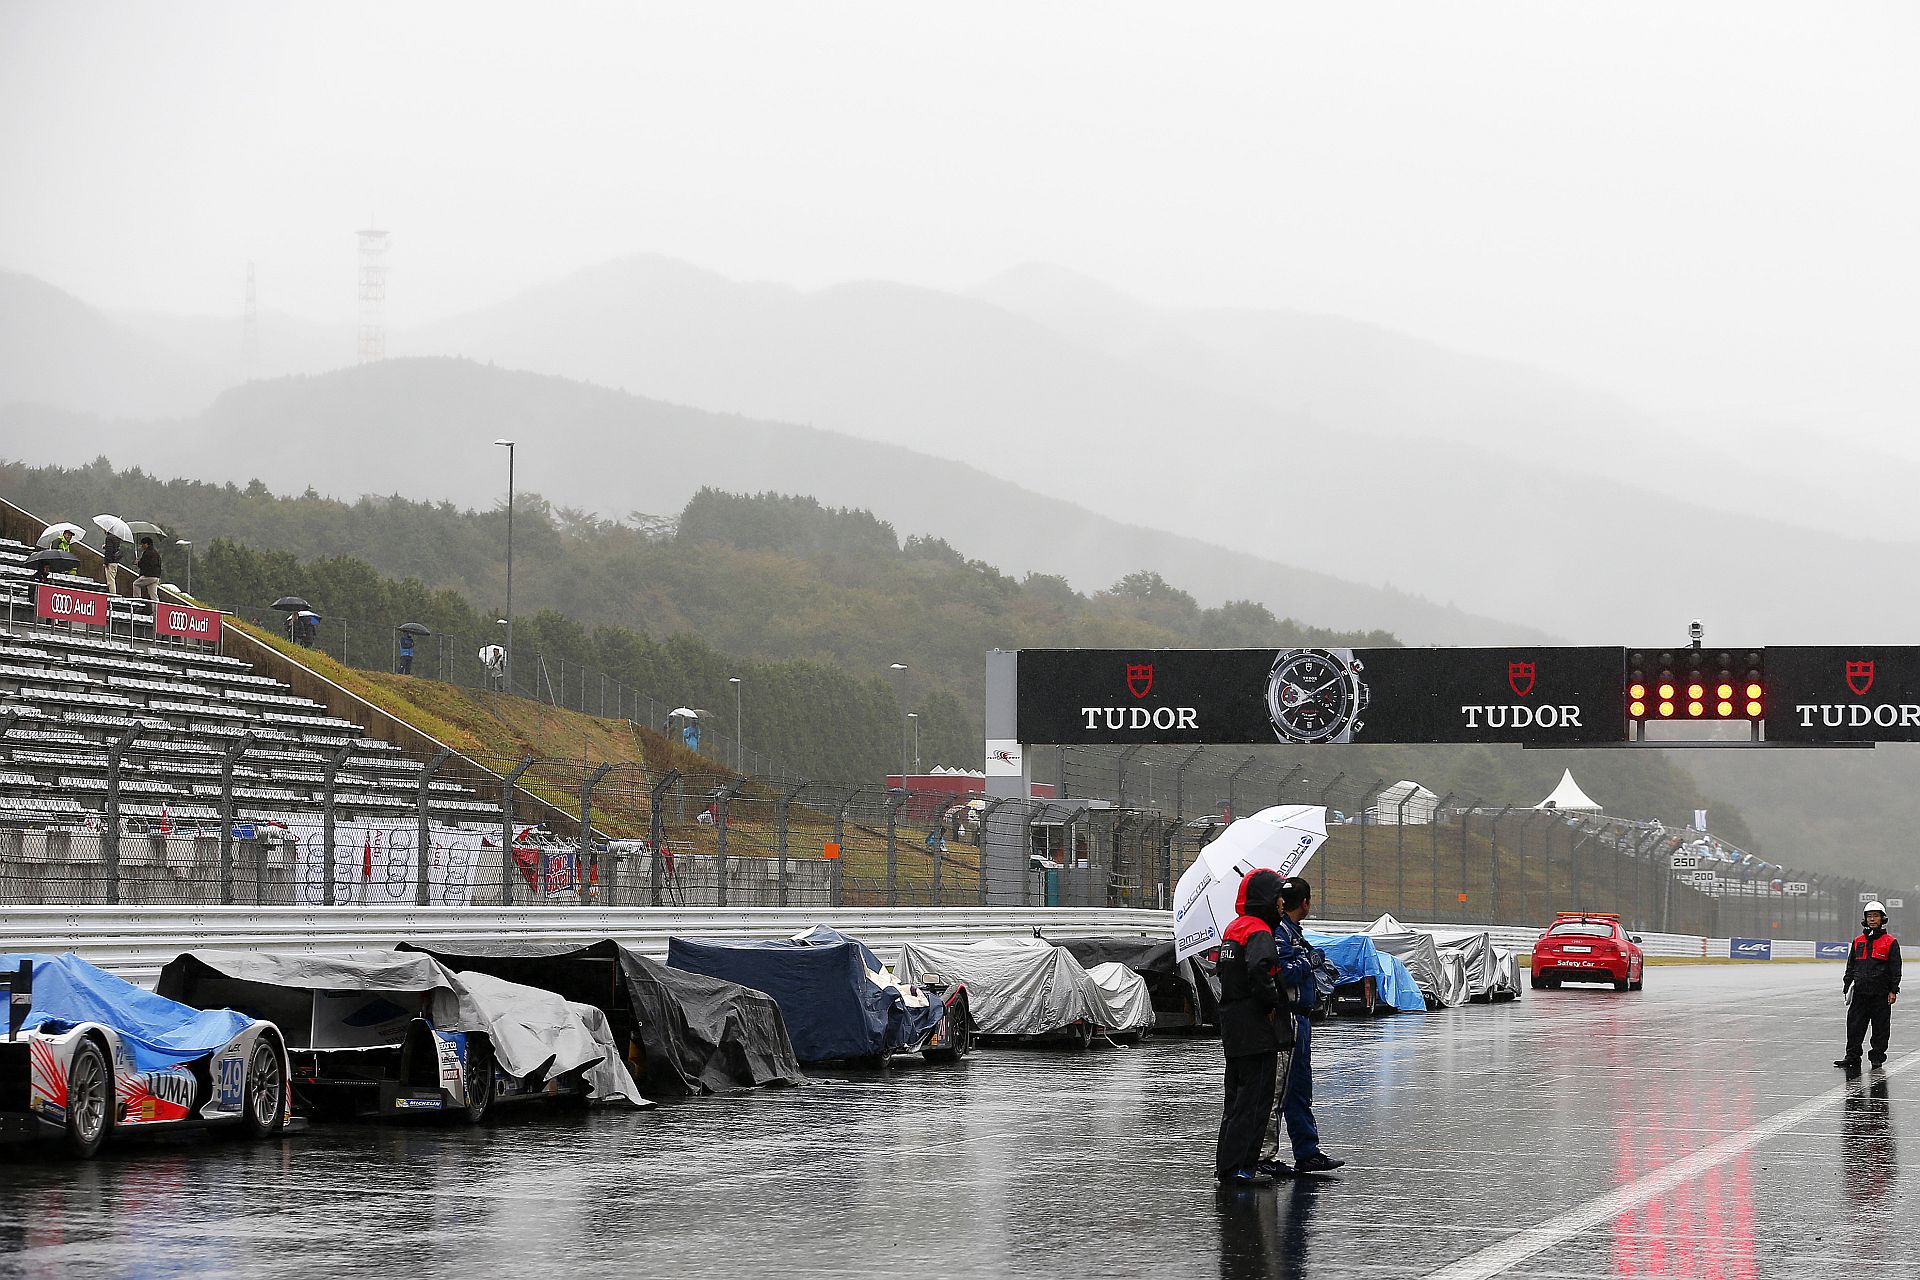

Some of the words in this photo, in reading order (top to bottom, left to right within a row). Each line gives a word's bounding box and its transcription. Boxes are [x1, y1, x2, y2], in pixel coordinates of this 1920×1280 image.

[74, 598, 95, 617] Audi
[189, 616, 209, 633] Audi
[1081, 707, 1200, 730] TUDOR
[1461, 705, 1583, 729] TUDOR
[1796, 704, 1920, 728] TUDOR
[1673, 857, 1696, 867] 250
[1694, 872, 1713, 881] 200
[1789, 884, 1805, 892] 150
[1738, 943, 1770, 952] WEC
[1557, 960, 1581, 968] Safety
[223, 1061, 242, 1098] 49
[409, 1099, 441, 1107] MICHELIN
